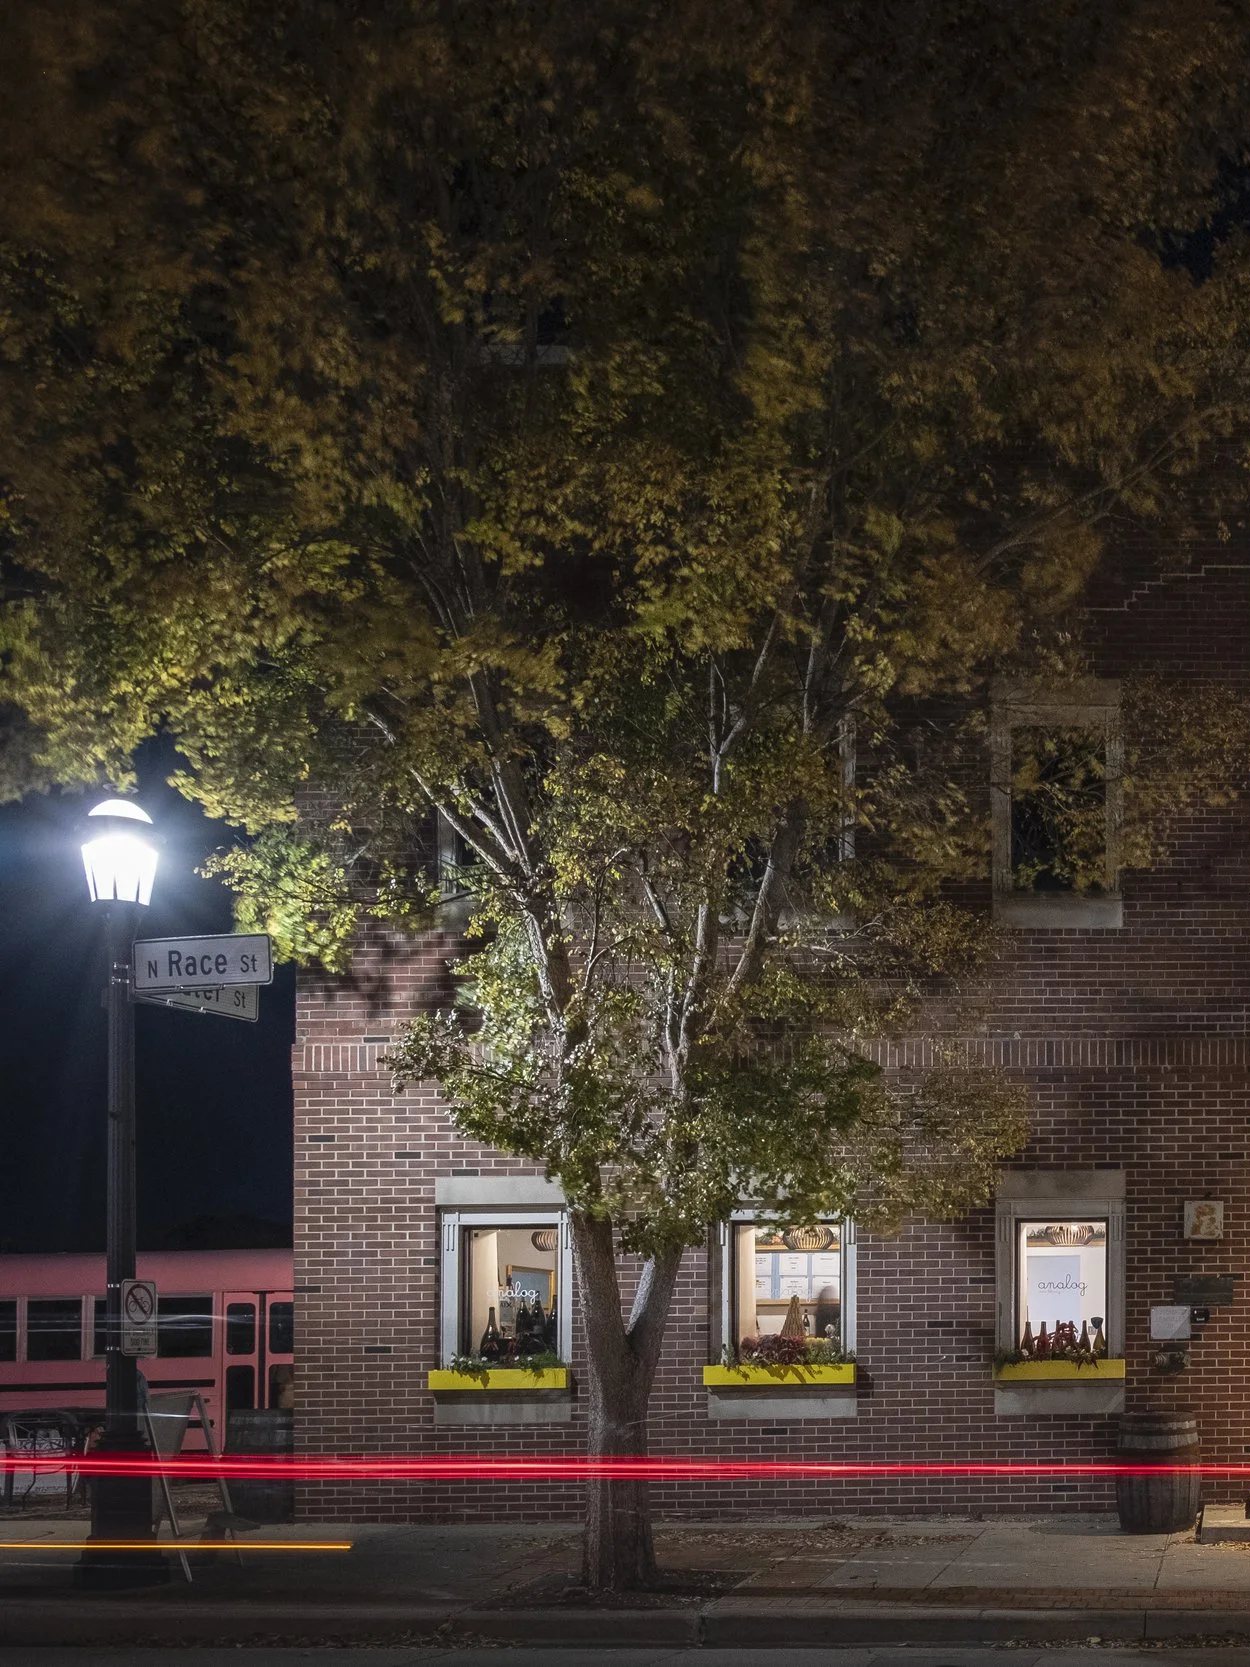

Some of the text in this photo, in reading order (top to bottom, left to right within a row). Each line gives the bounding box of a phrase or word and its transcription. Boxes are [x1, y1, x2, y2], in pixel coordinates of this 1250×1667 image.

[147, 949, 258, 979] N Race St
[233, 990, 246, 1009] St
[1037, 1273, 1089, 1297] analog
